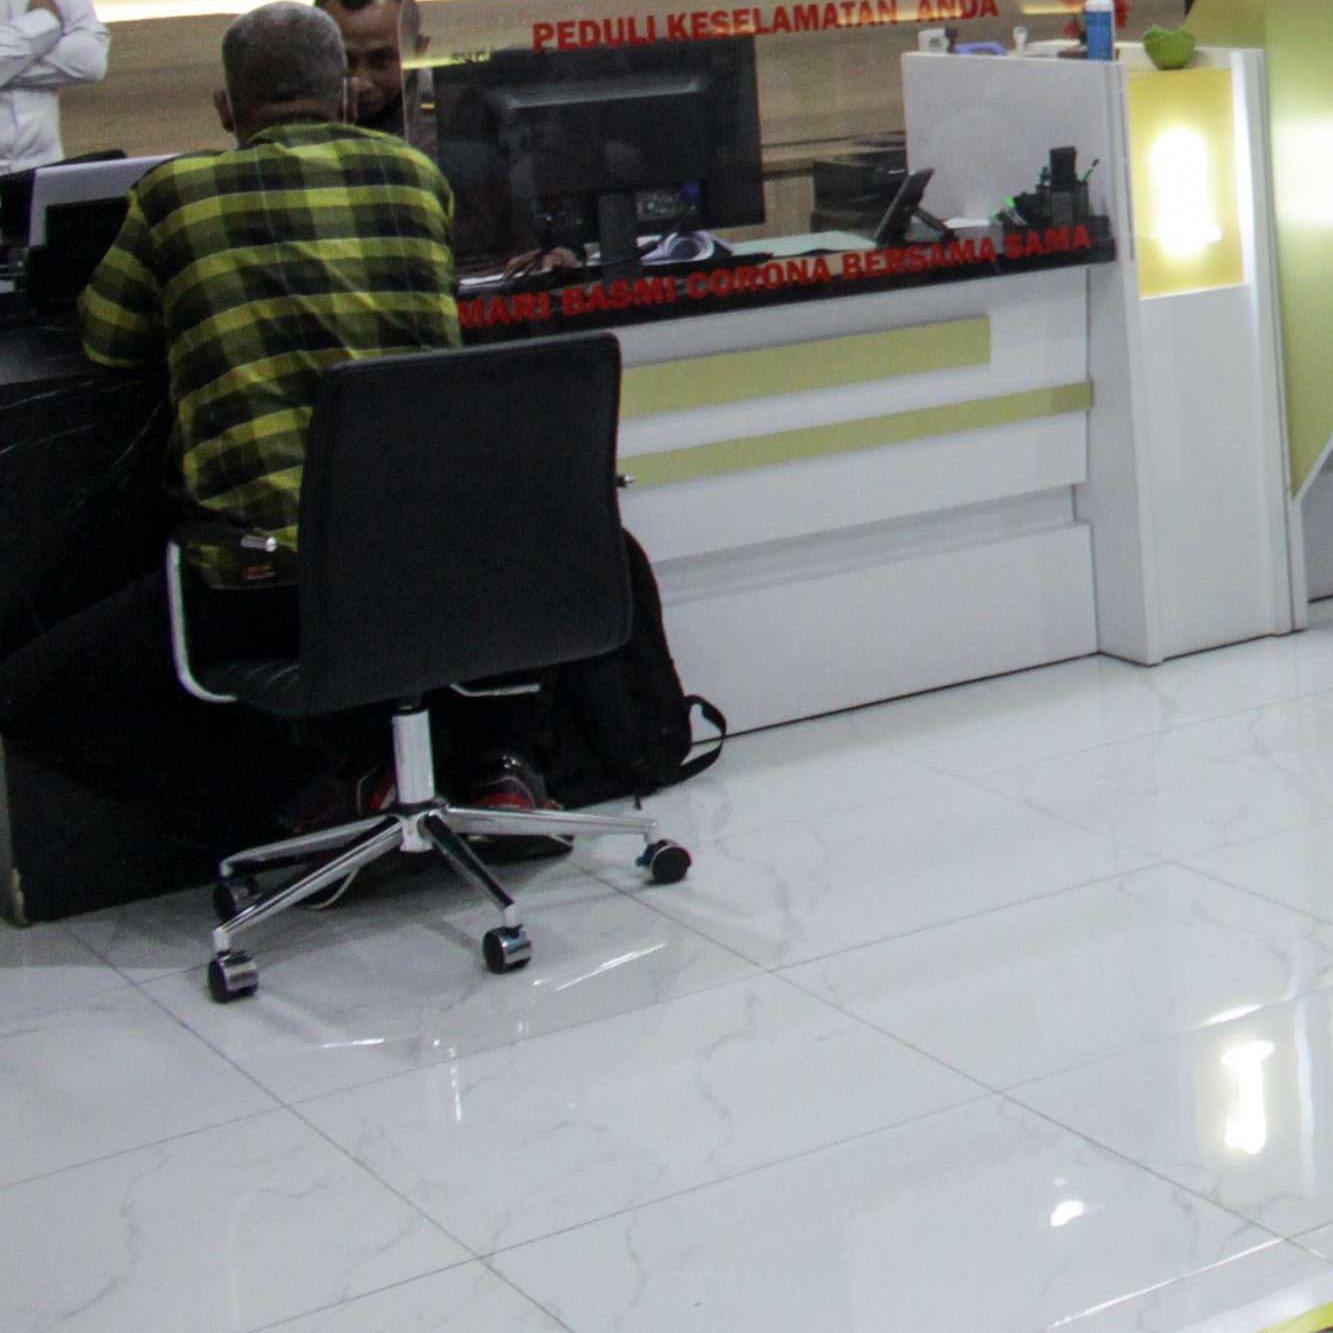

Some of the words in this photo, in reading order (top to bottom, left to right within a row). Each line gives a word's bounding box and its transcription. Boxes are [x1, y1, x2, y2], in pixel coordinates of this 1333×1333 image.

[532, 13, 658, 53] PEDULI
[457, 289, 550, 330] MARI
[561, 275, 677, 318] BASMI
[686, 256, 834, 301] CORONA
[841, 235, 999, 278] BERSAMA
[1005, 224, 1092, 255] SAMA
